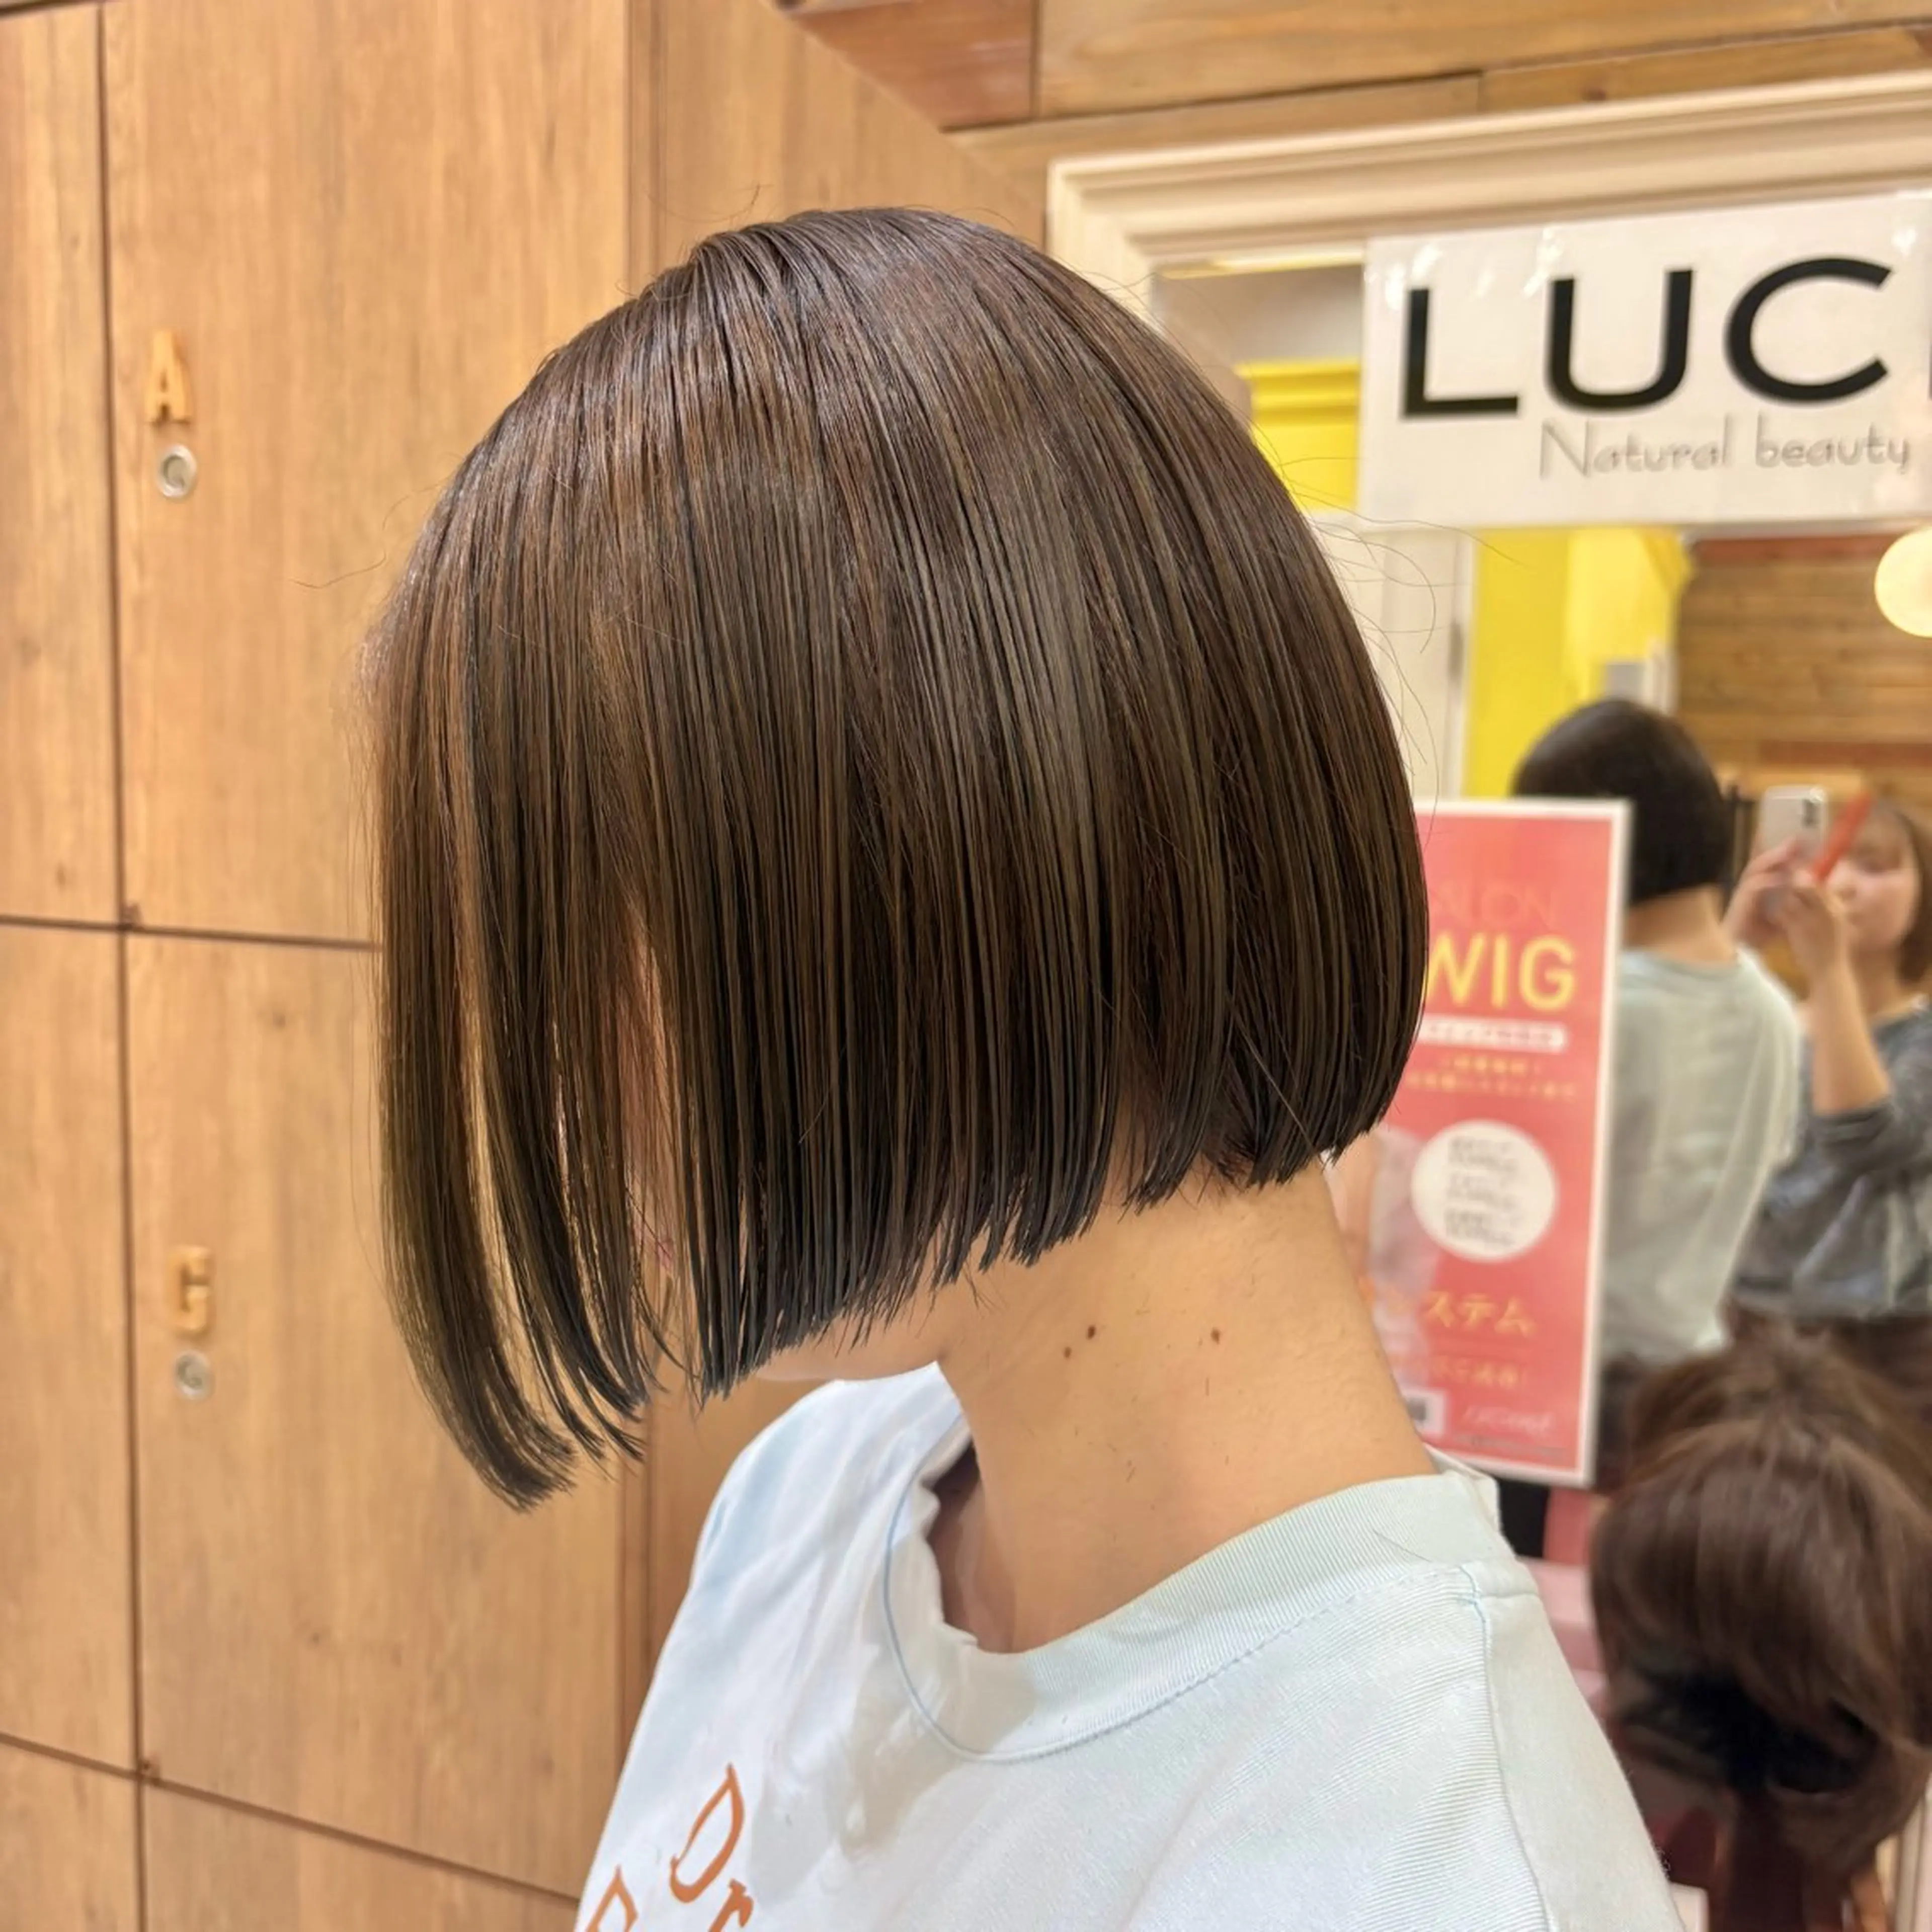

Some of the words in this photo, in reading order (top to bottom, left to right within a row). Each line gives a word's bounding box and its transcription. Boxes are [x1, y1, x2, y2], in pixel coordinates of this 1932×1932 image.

[145, 329, 194, 425] A
[1400, 256, 1932, 421] LUC
[1540, 413, 1732, 478] Natural
[1755, 409, 1912, 475] beauty
[1420, 930, 1578, 1013] WIG
